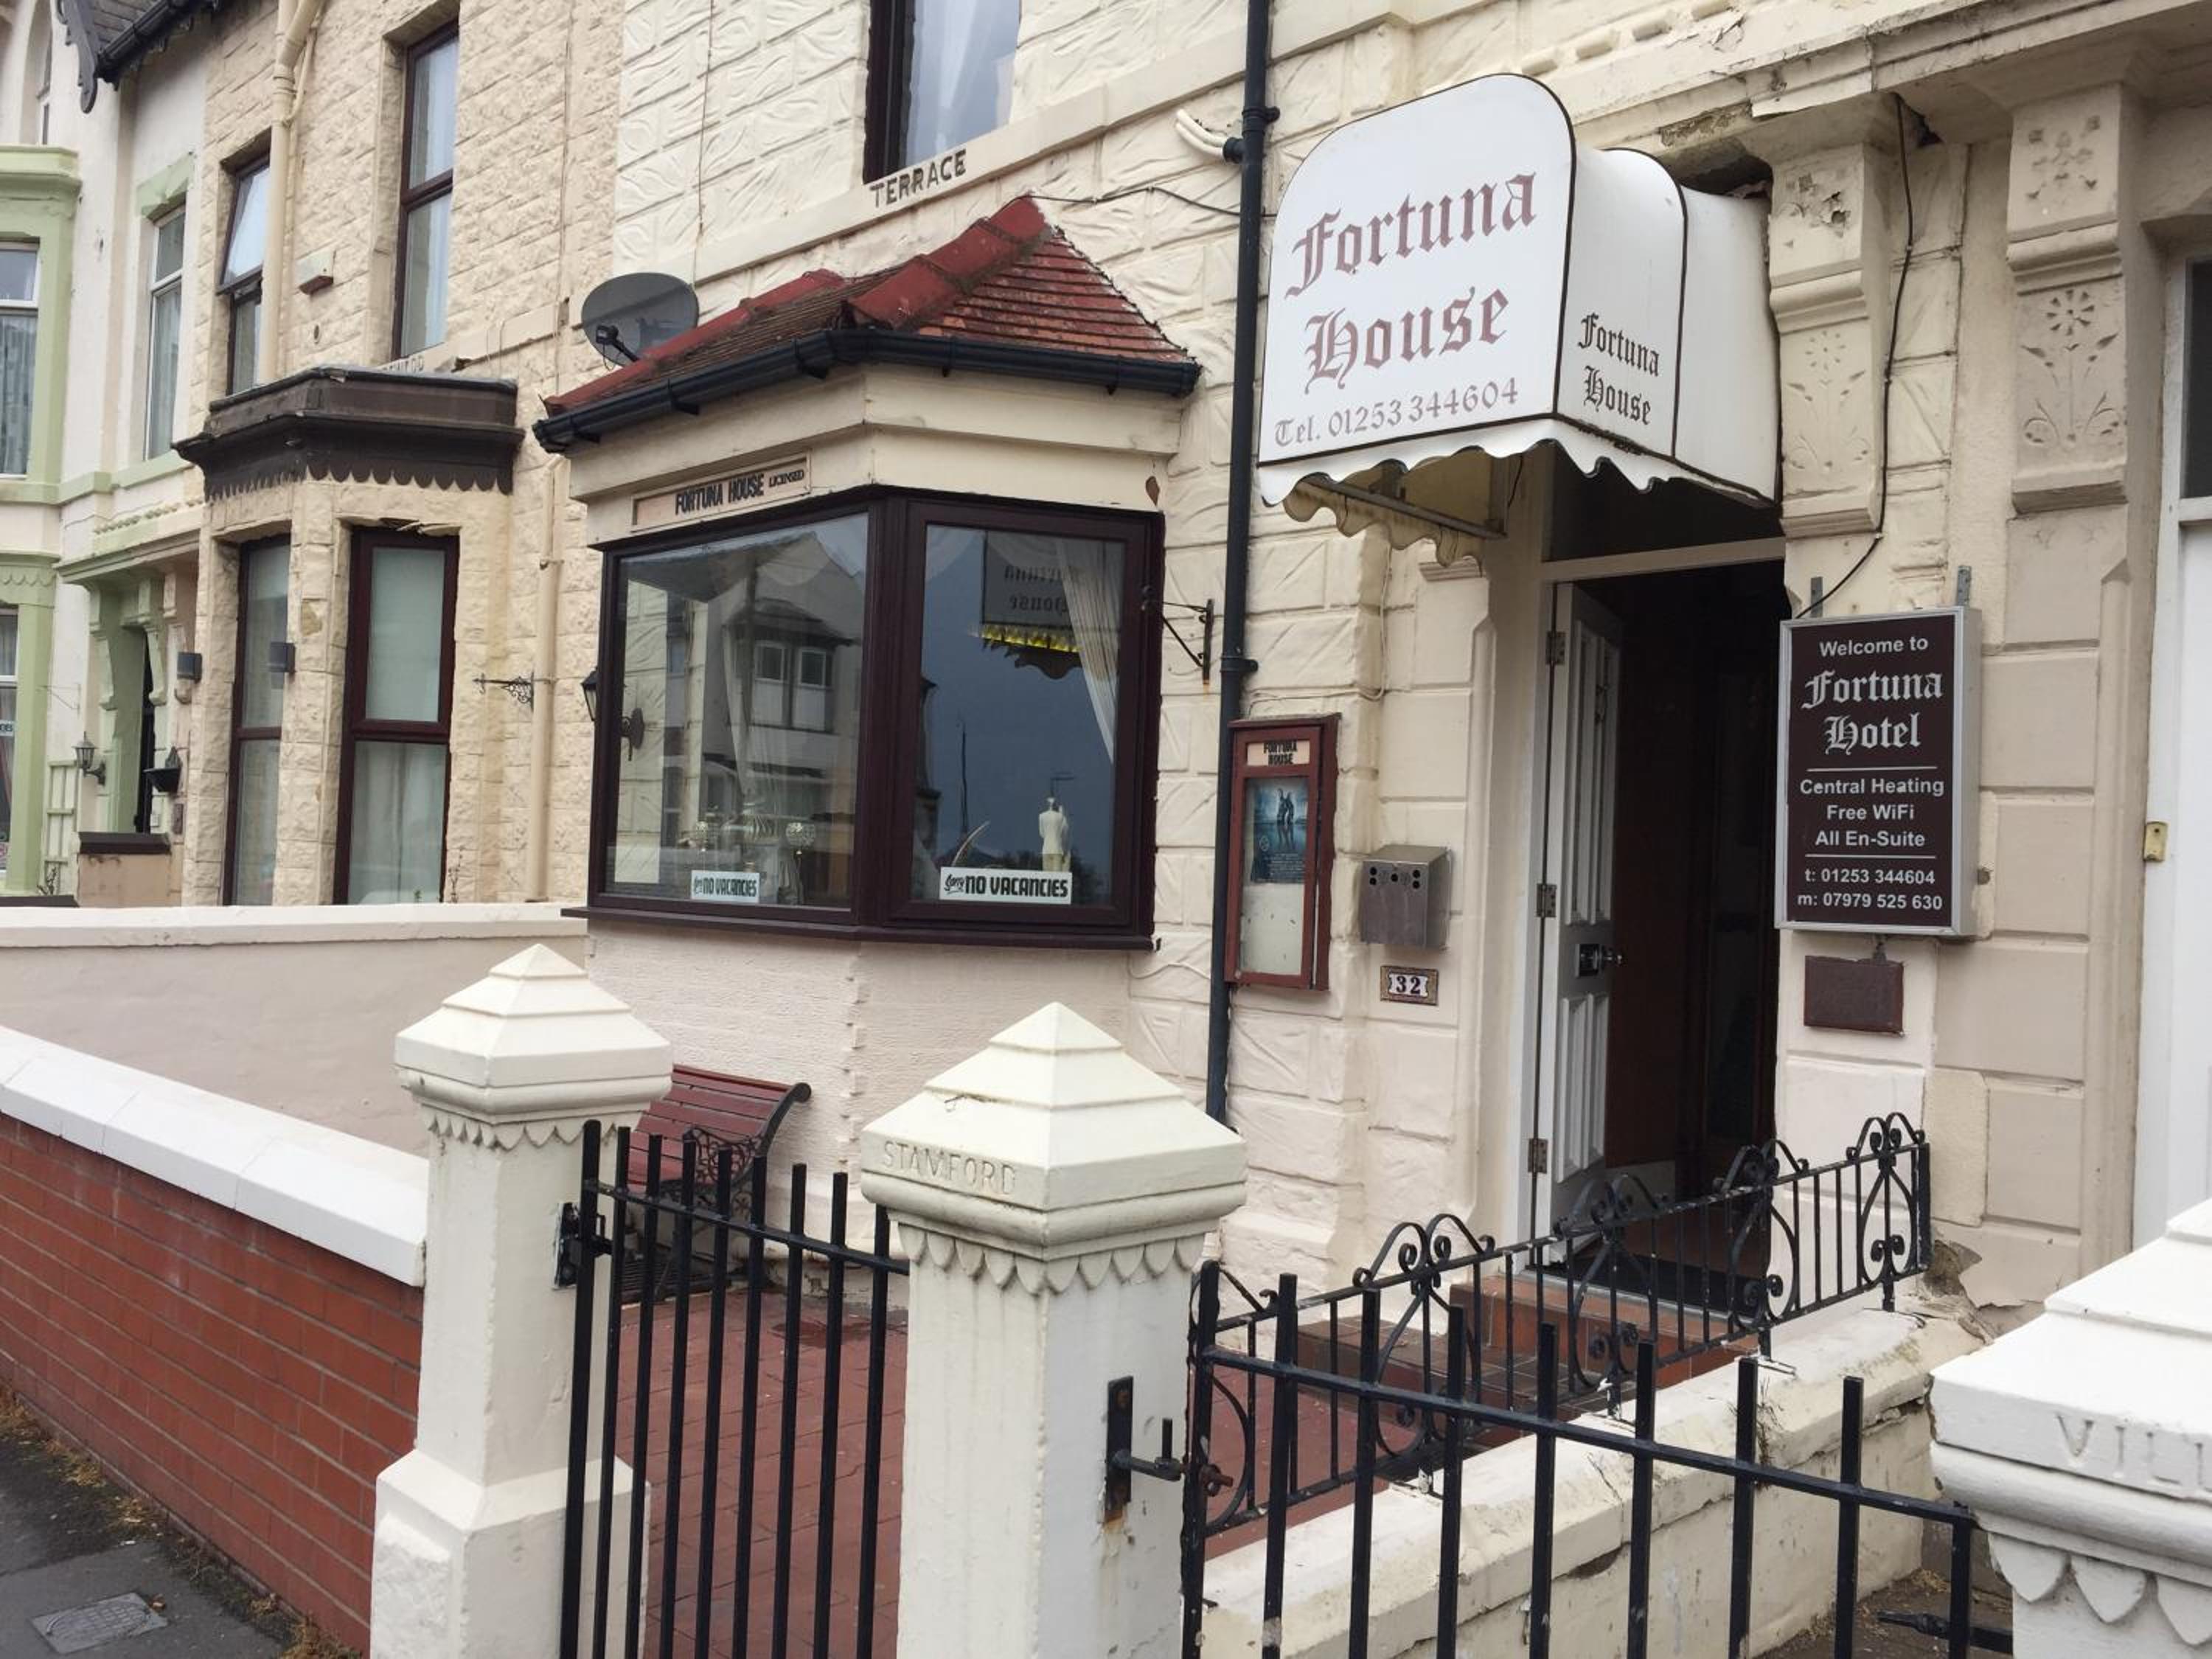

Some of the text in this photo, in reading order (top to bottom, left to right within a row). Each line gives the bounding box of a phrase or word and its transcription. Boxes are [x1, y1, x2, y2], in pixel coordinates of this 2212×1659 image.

[869, 149, 967, 207] TERRACE
[1284, 171, 1537, 299] Fortuna
[1304, 285, 1509, 394] House
[1578, 313, 1658, 377] Fortuna
[1275, 378, 1518, 446] Tel. 01253 344604
[1583, 366, 1651, 425] House
[675, 482, 723, 515] FORTUNA
[728, 472, 765, 503] HOUSE
[1820, 636, 1928, 657] Welcome to
[1801, 669, 1943, 709] Fortuna
[1823, 712, 1921, 755] Hotel
[1800, 777, 1944, 796] Central Heating
[1826, 804, 1914, 821] Free WiFi
[1815, 830, 1925, 846] All En-Suite
[965, 875, 987, 894] NO
[990, 877, 1068, 897] VACANCIES
[1805, 868, 1935, 885] t: 01253 344604
[1798, 893, 1942, 910] m: 07979 525 630
[1396, 975, 1421, 994] 32
